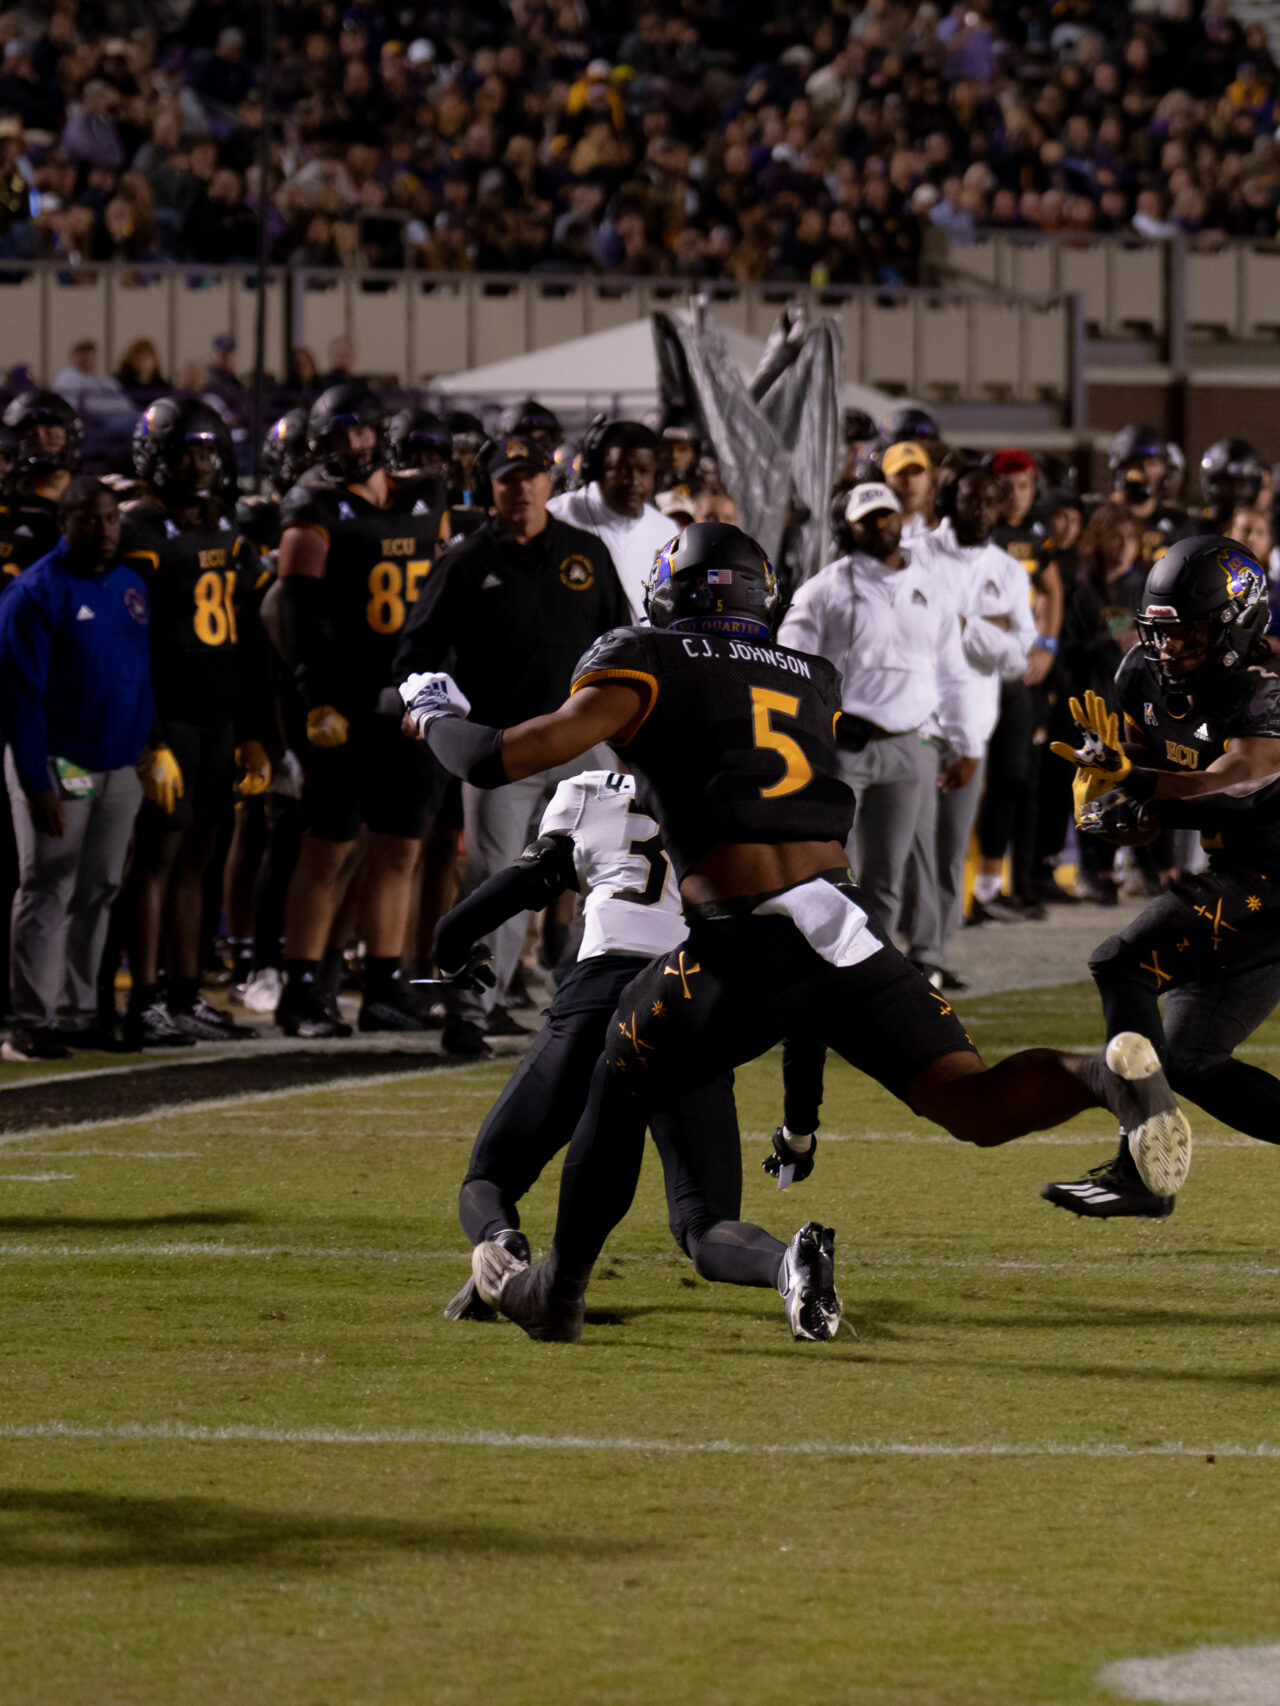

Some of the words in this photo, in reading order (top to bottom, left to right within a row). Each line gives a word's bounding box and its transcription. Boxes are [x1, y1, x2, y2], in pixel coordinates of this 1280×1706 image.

[380, 537, 417, 557] ECU
[716, 599, 725, 613] 5
[702, 620, 760, 635] QUARTER
[728, 642, 811, 679] JOHNSON
[749, 685, 823, 799] 5
[1164, 739, 1199, 770] ECU
[609, 796, 672, 906] 3
